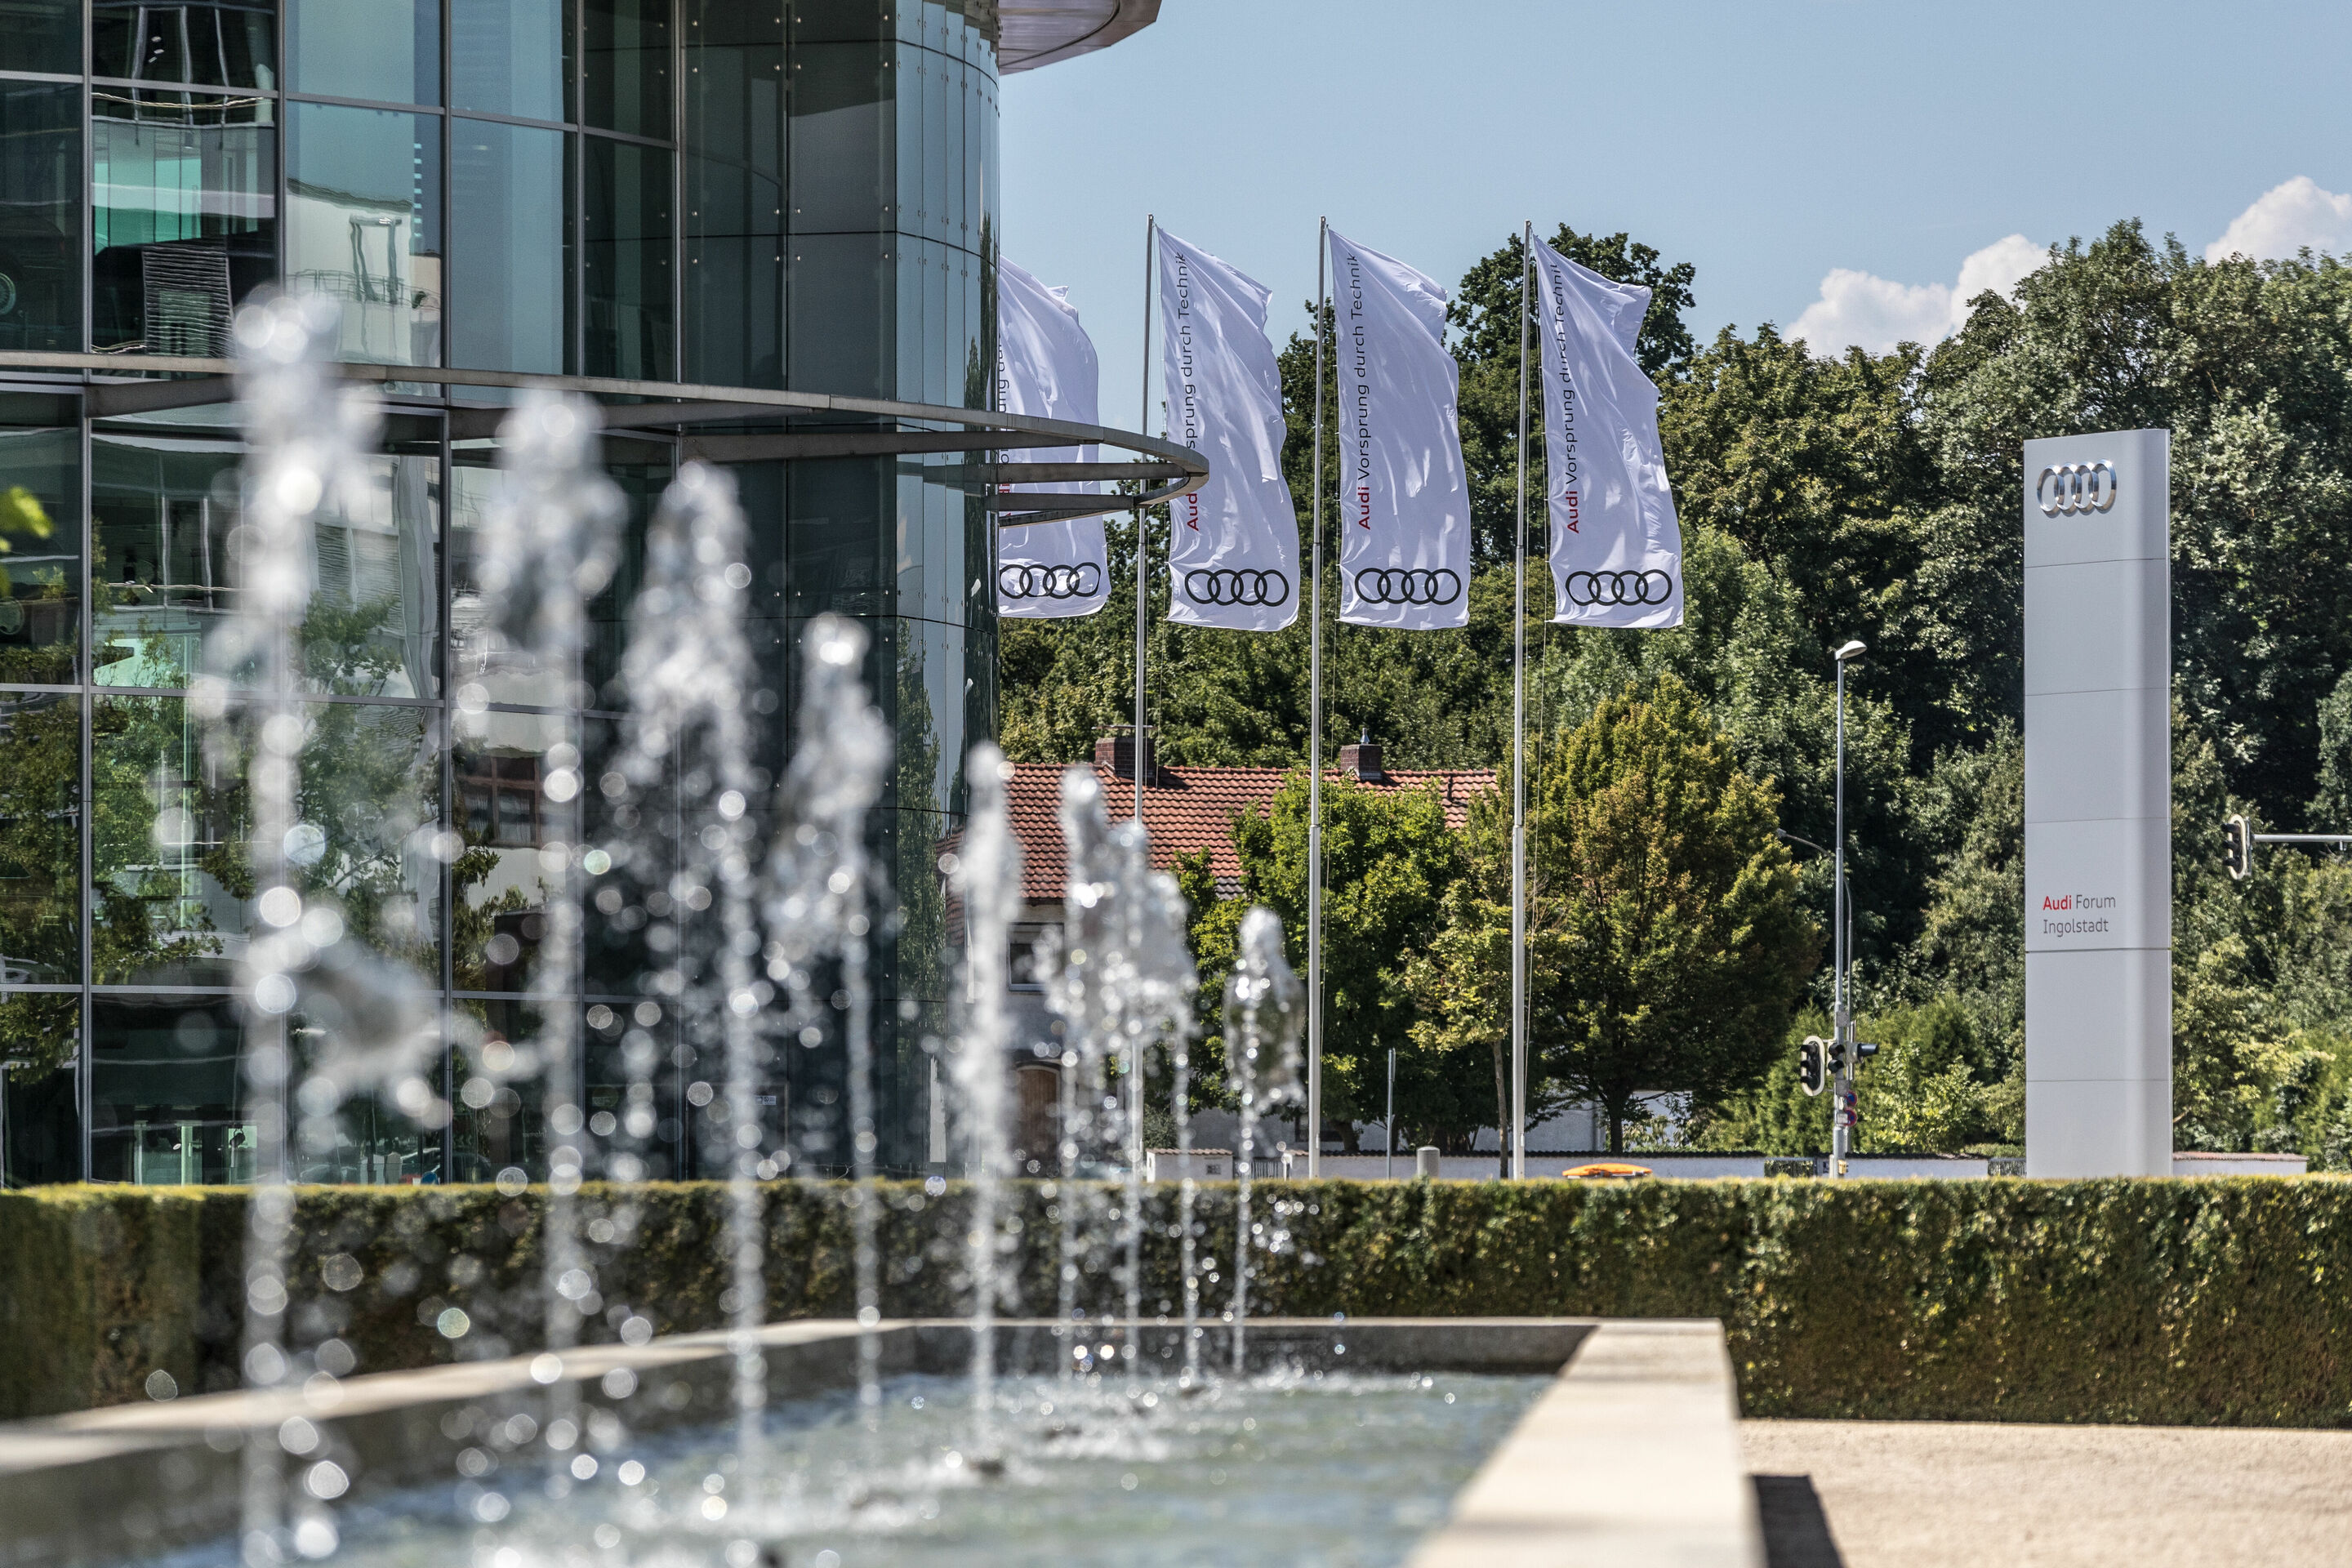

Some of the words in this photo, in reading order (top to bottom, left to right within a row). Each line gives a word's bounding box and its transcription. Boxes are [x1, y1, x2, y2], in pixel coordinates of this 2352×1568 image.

[1175, 252, 1190, 319] Technik
[1347, 252, 1364, 320] Technik
[1180, 326, 1193, 377] durch
[1353, 326, 1366, 378] durch
[1557, 332, 1572, 383] durch
[1185, 384, 1198, 448] sprung
[1357, 385, 1372, 480] Vorsprung
[1563, 390, 1578, 484] Vorsprung
[1186, 492, 1200, 531] Aud
[1358, 487, 1371, 530] Audi
[1566, 491, 1580, 534] Audi
[2042, 895, 2072, 911] Audi
[2076, 894, 2116, 909] Forum
[2043, 918, 2109, 938] Ingolstadt
